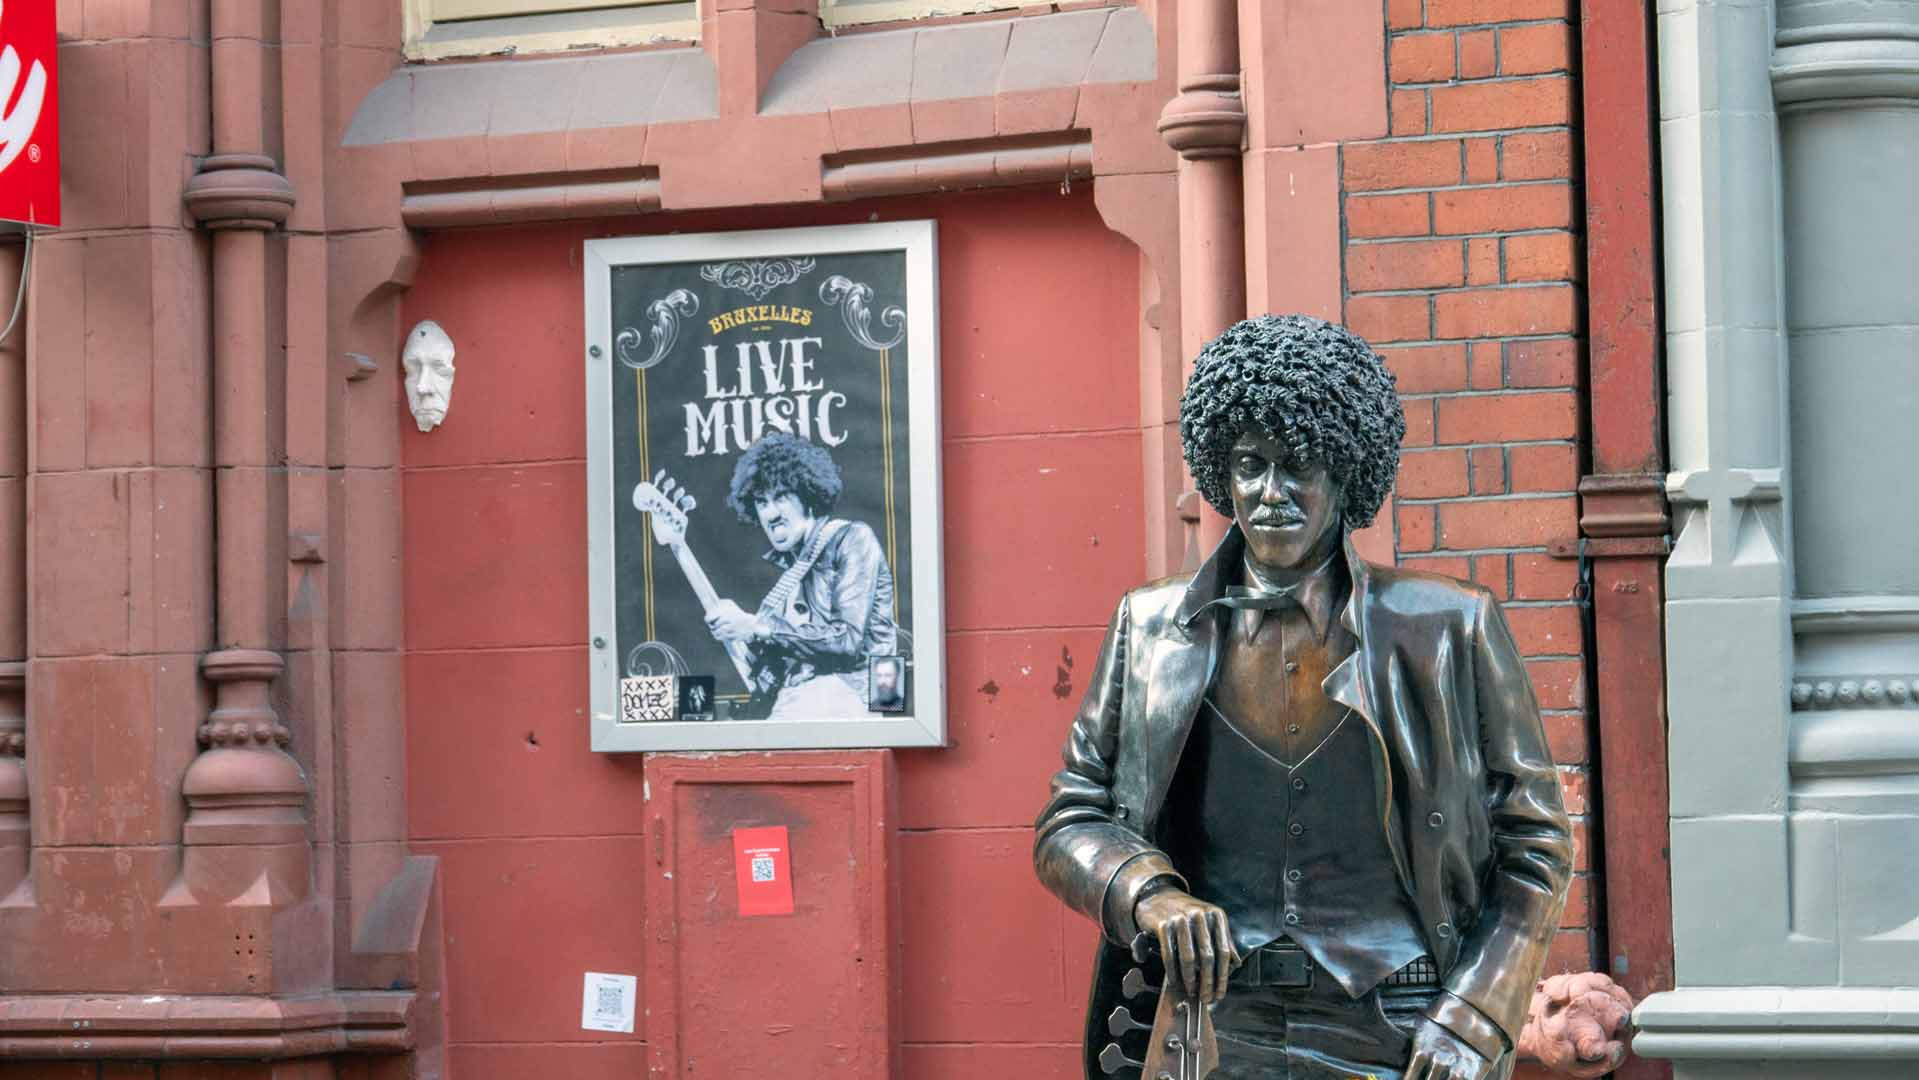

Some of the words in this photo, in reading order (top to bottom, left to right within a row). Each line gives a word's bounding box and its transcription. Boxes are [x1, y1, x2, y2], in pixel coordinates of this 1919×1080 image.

[708, 304, 813, 335] BRUXELLES
[702, 336, 824, 399] LIVE
[682, 390, 848, 457] MUSIC
